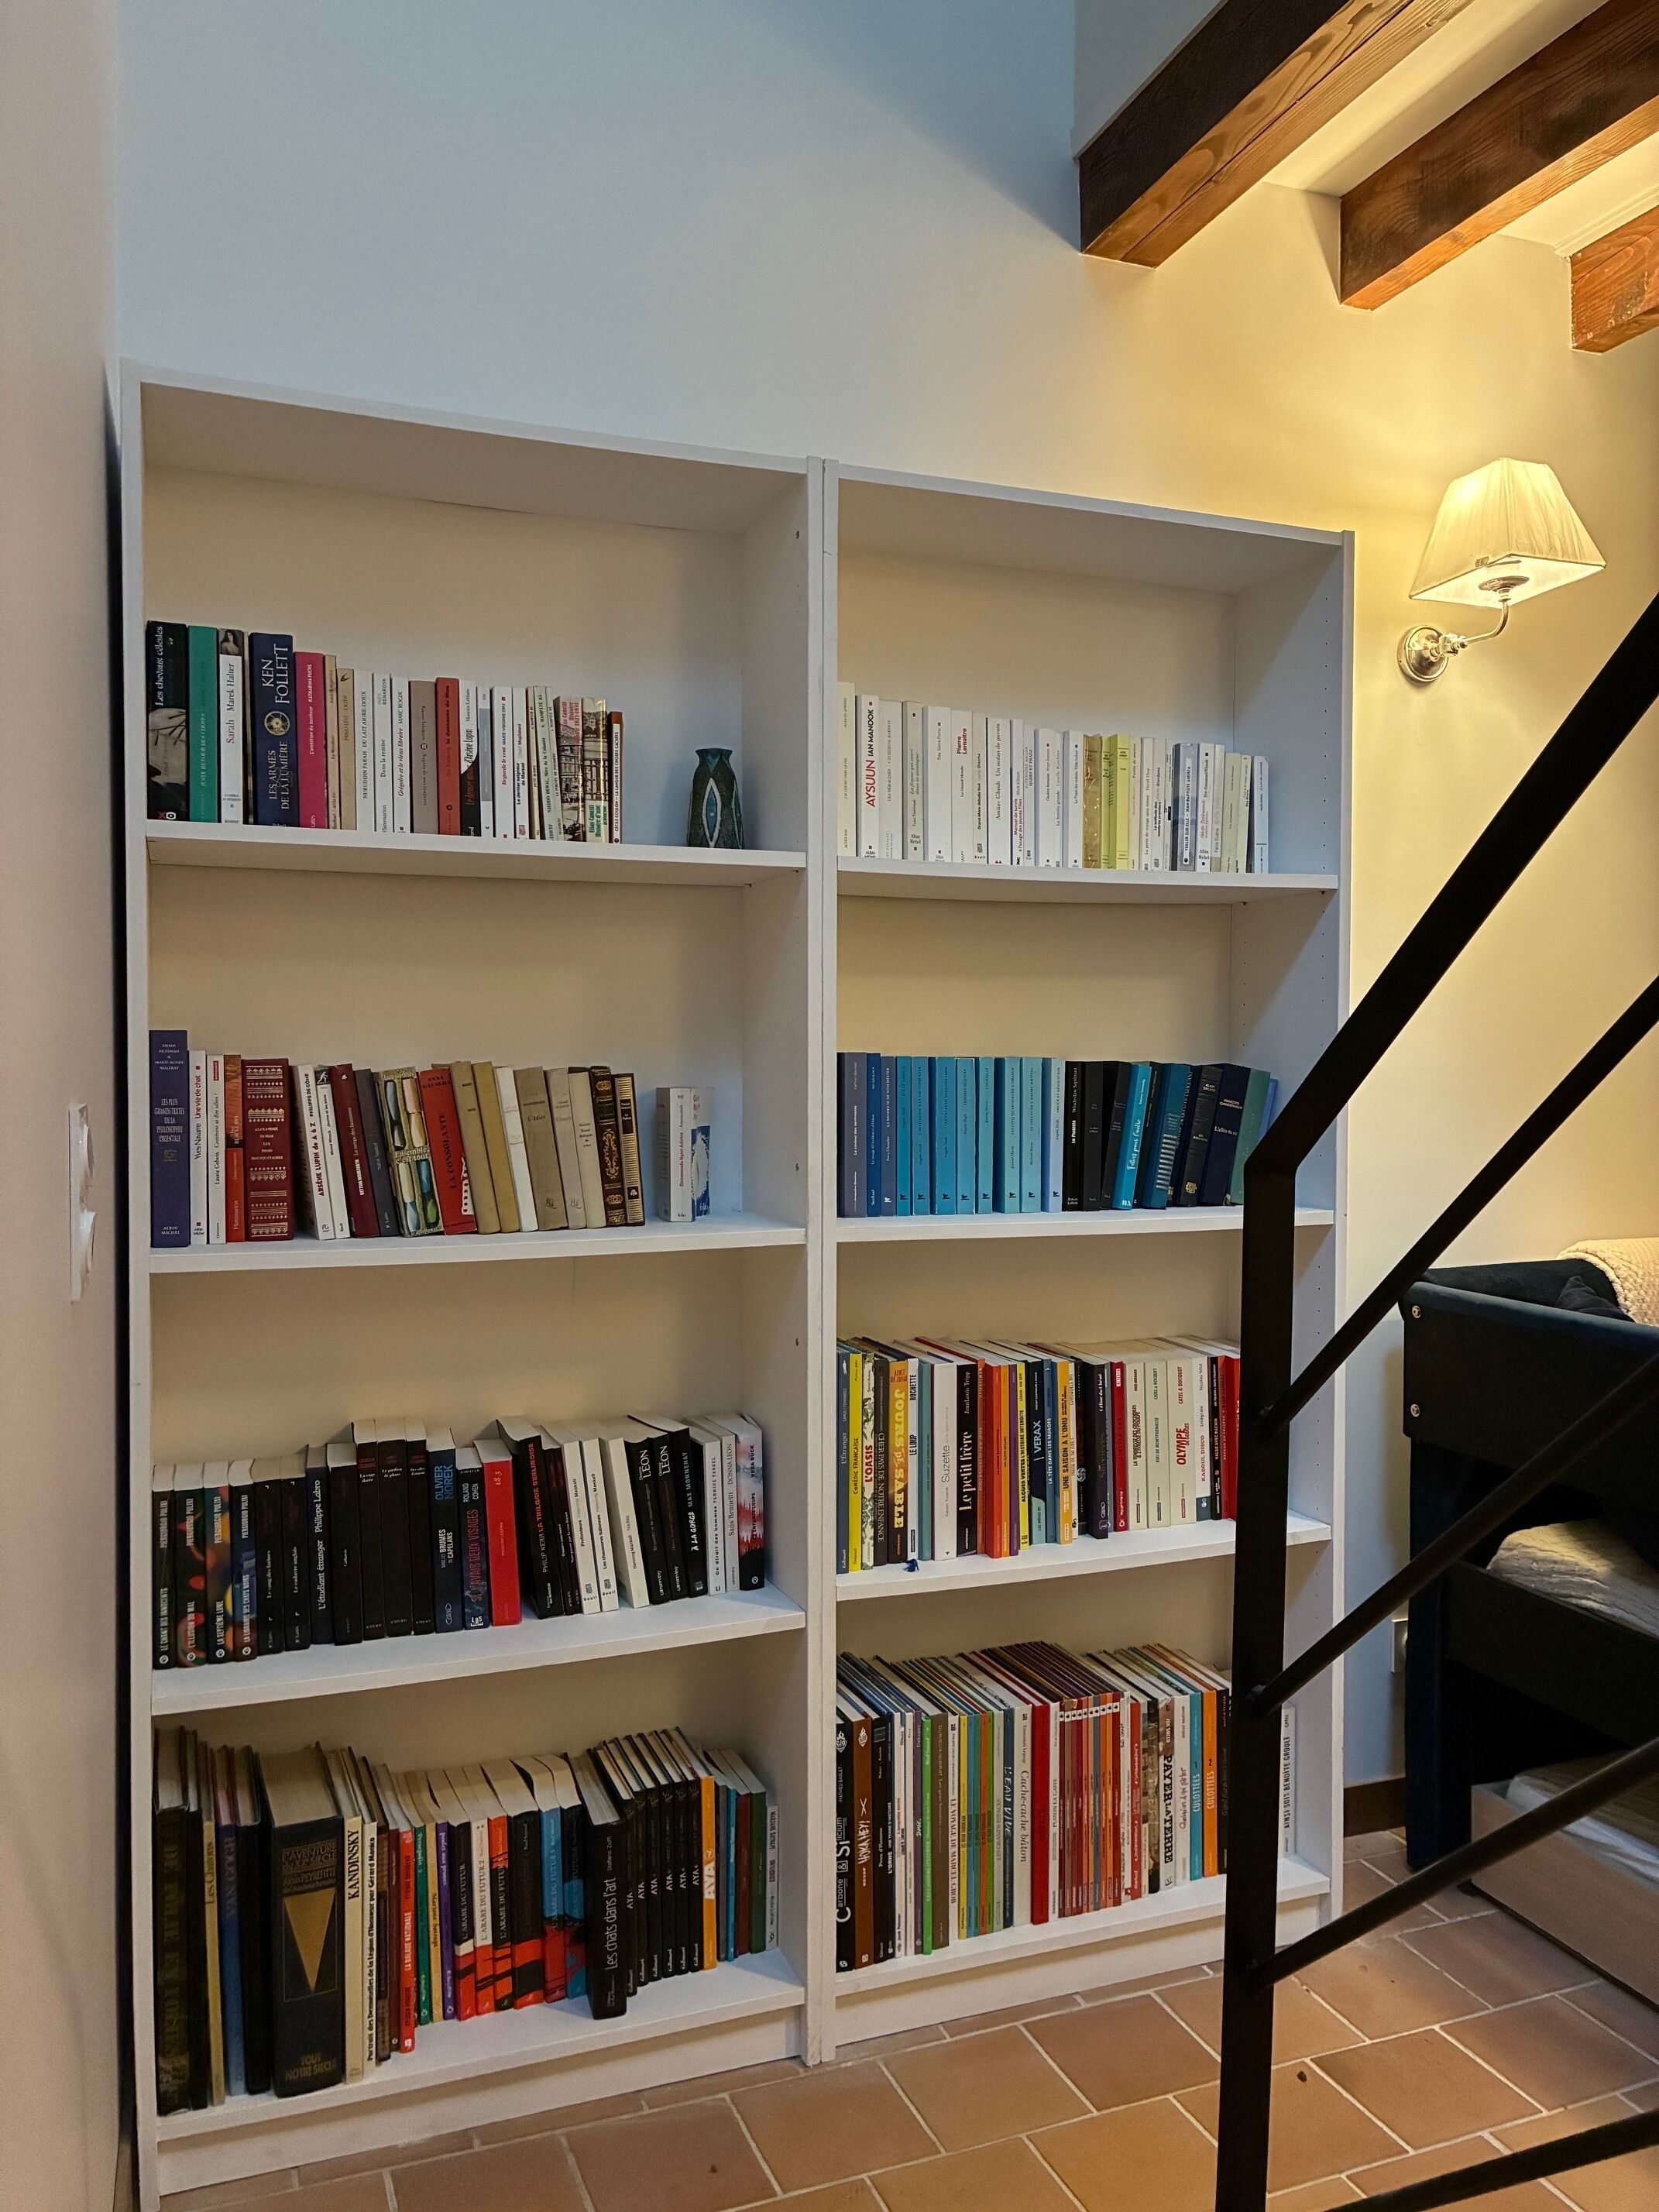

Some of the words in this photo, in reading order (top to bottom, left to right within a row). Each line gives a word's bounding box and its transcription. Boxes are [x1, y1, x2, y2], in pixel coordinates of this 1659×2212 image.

[154, 626, 163, 655] célestes
[154, 658, 163, 689] chevaux
[226, 664, 235, 686] Halter
[262, 659, 273, 687] KEN
[274, 644, 290, 704] FOLLETT
[154, 692, 163, 706] Les
[226, 720, 235, 744] Sarah
[463, 729, 473, 742] Lupin
[268, 750, 277, 782] ARMES
[279, 741, 289, 783] LUMIÈRE
[463, 743, 473, 763] d'Arsène
[866, 760, 875, 807] AYSUUN
[996, 768, 1000, 776] Un
[269, 784, 277, 799] LES
[280, 784, 289, 795] LA
[281, 796, 290, 809] DE
[439, 1114, 455, 1174] CONSOLANTE
[315, 1173, 325, 1196] ARSÈNE
[449, 1176, 457, 1190] LA
[892, 1389, 905, 1448] JOURS
[960, 1431, 972, 1462] frère
[1033, 1420, 1042, 1453] VERAX
[1176, 1428, 1187, 1465] OLYMPE
[639, 1450, 651, 1479] LEON
[659, 1445, 671, 1474] LEON
[941, 1445, 950, 1482] Suzette
[434, 1466, 444, 1499] OLIVIER
[444, 1465, 454, 1499] NOREK
[878, 1472, 884, 1482] DE
[960, 1463, 976, 1492] petit
[313, 1480, 321, 1503] Labro
[894, 1468, 904, 1528] SABLE
[960, 1495, 972, 1510] Le
[314, 1503, 323, 1533] Philippe
[688, 1511, 697, 1532] GORGE
[690, 1534, 698, 1544] LA
[317, 1572, 326, 1609] L'étudiant
[1163, 1754, 1173, 1799] PAYER
[1165, 1802, 1171, 1812] LA
[857, 1821, 870, 1839] HEY!
[1164, 1815, 1173, 1863] TERRE
[348, 1830, 359, 1900] KANDINSKY
[857, 1839, 871, 1864] HOKA
[603, 1877, 616, 1895] l'art
[703, 1861, 715, 1899] AYA
[603, 1898, 617, 1922] dans
[366, 1939, 375, 1960] Légion
[605, 1925, 617, 1951] chats
[368, 1969, 373, 1978] de
[605, 1953, 617, 1970] Les
